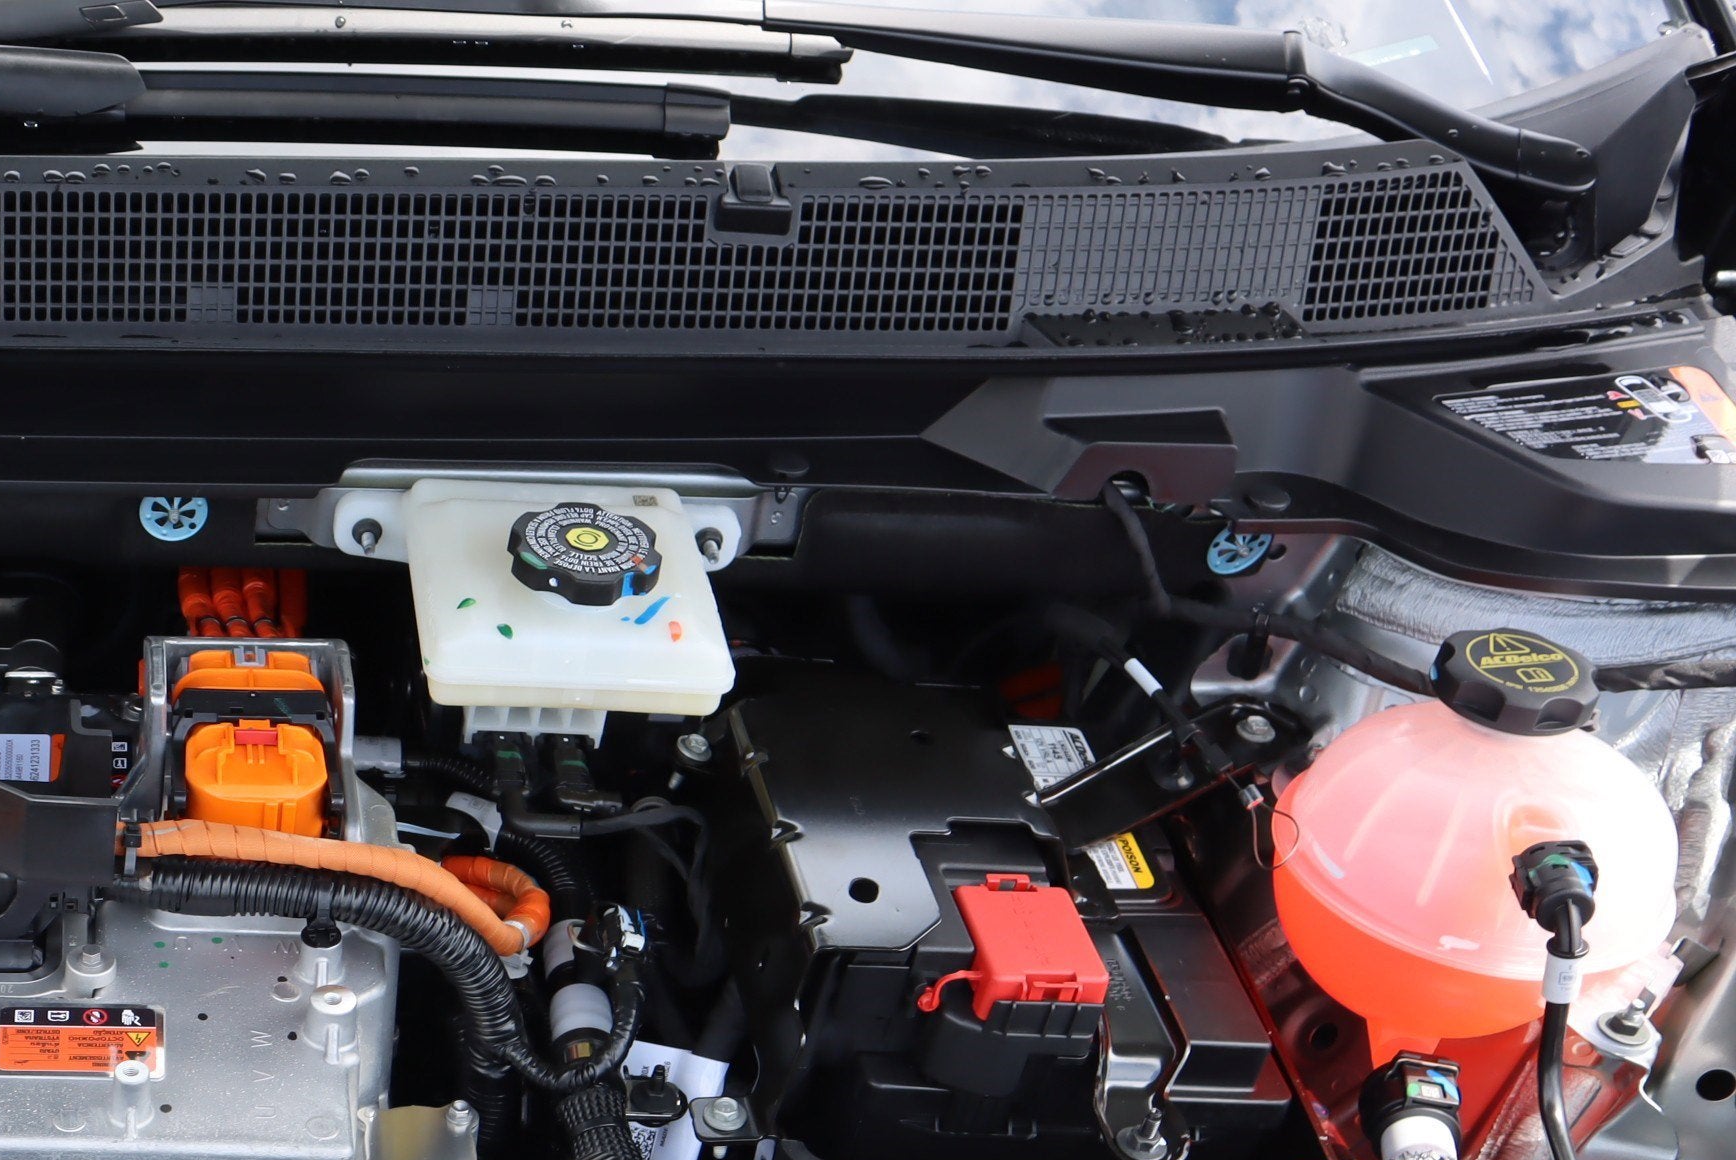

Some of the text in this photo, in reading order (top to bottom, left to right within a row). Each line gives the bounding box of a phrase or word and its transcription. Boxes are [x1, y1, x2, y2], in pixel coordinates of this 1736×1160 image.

[580, 560, 605, 568] FREIN
[596, 565, 622, 573] AVANT
[1480, 653, 1563, 665] ACDelco
[1118, 837, 1143, 873] POISON
